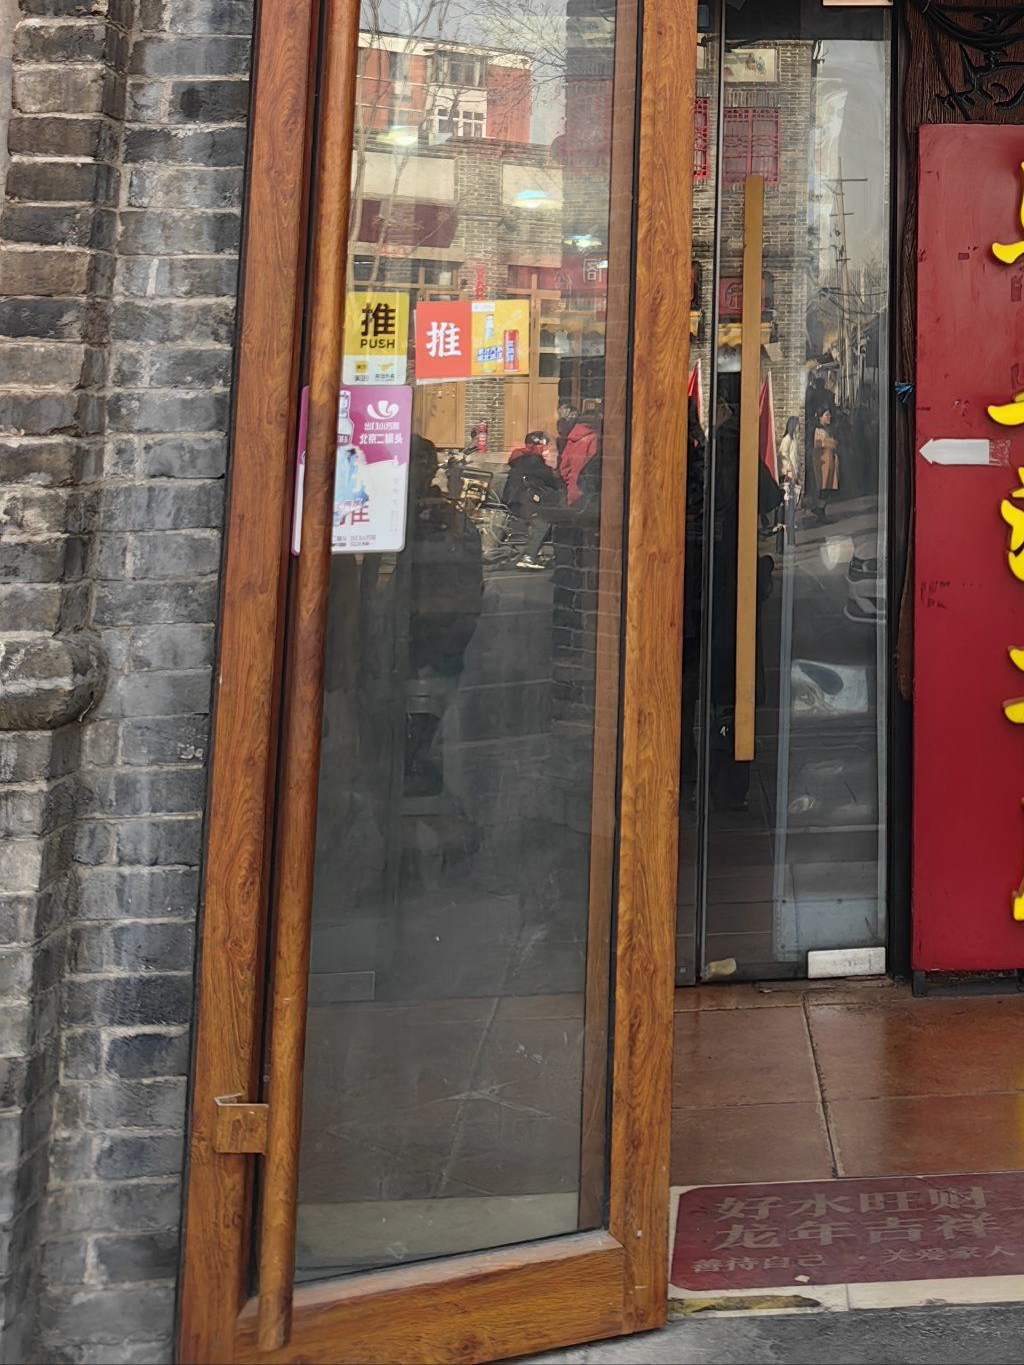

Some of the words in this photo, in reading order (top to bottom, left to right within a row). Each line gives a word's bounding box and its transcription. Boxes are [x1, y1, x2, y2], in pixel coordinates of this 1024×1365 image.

[361, 303, 396, 337] 推
[360, 338, 396, 349] PUSH
[426, 321, 462, 358] 推
[712, 1211, 1003, 1251] 龙年吉祥
